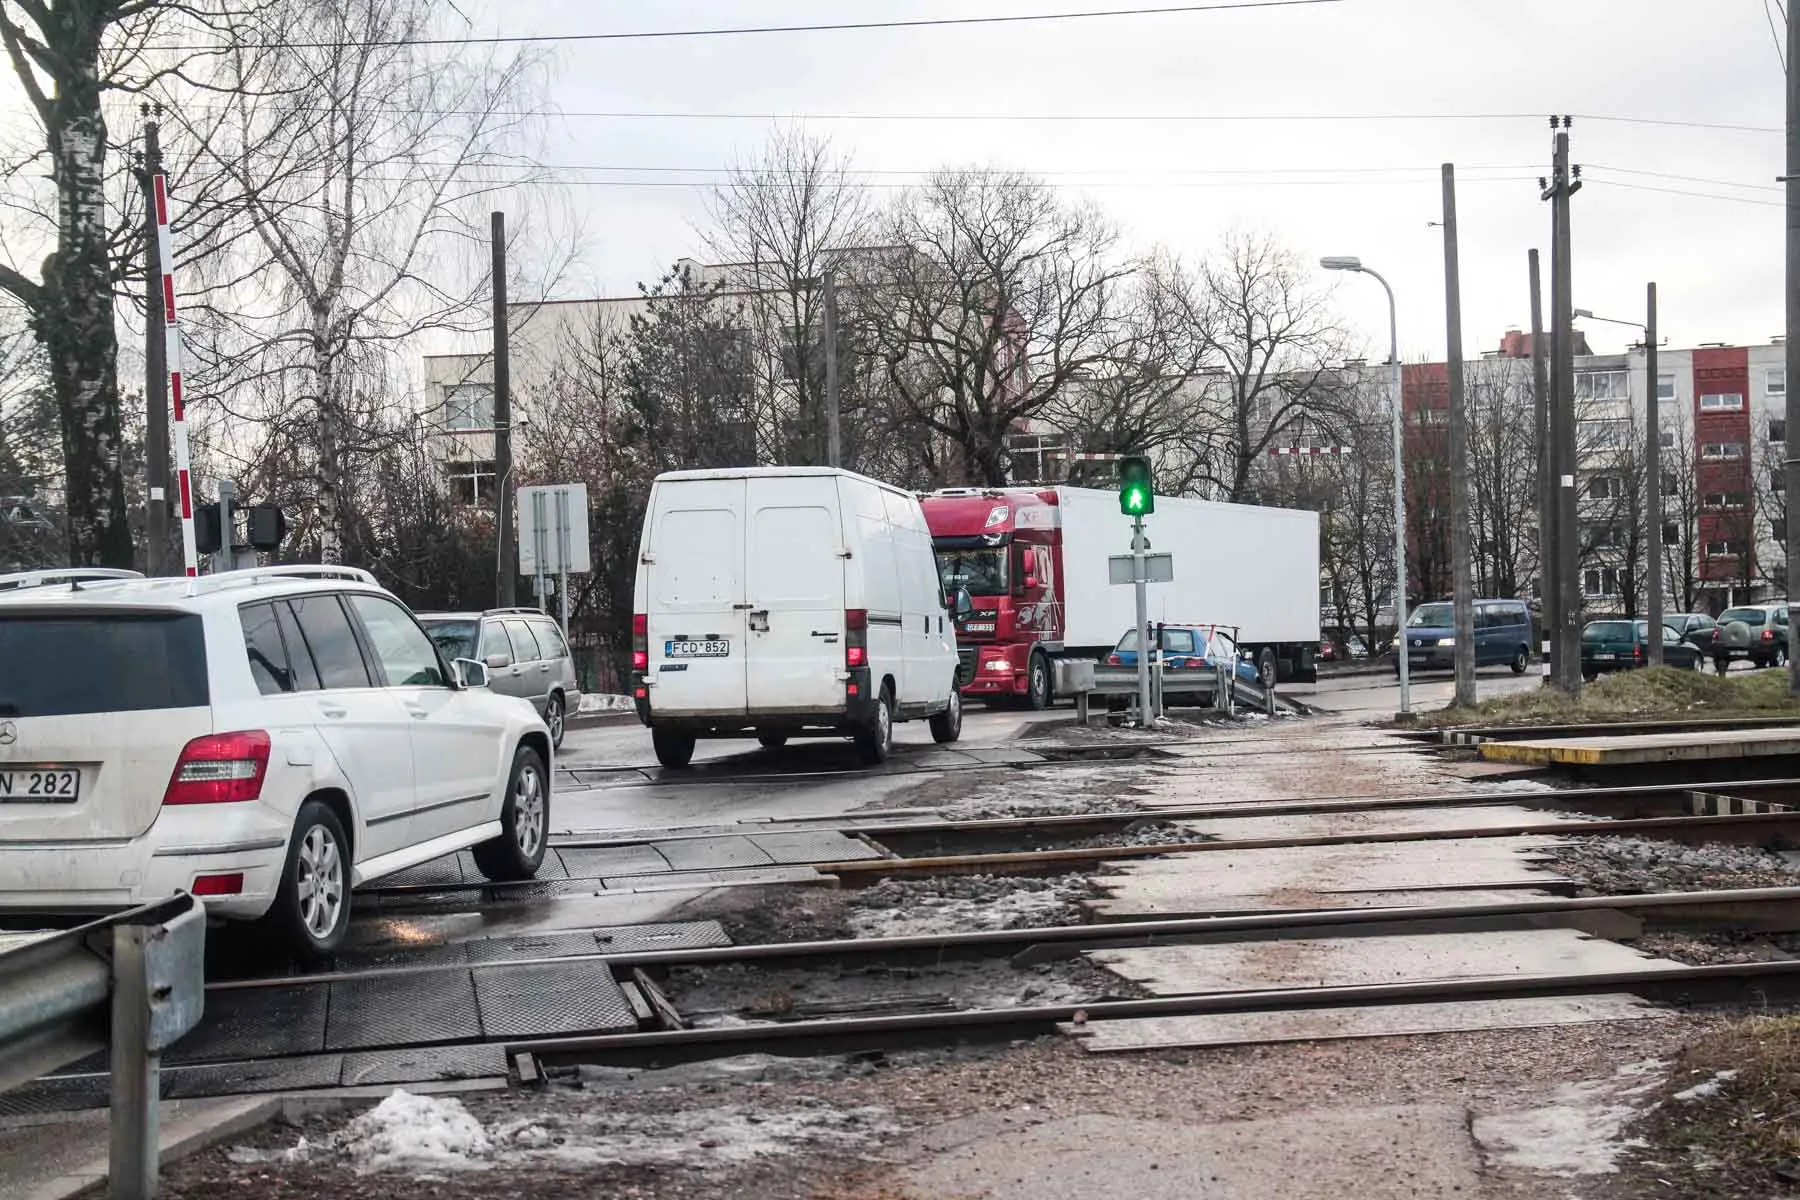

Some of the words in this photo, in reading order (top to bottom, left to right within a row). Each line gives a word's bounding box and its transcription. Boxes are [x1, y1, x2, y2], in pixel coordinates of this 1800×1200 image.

[673, 642, 698, 653] FCD
[705, 642, 726, 652] 852
[28, 773, 72, 794] 282
